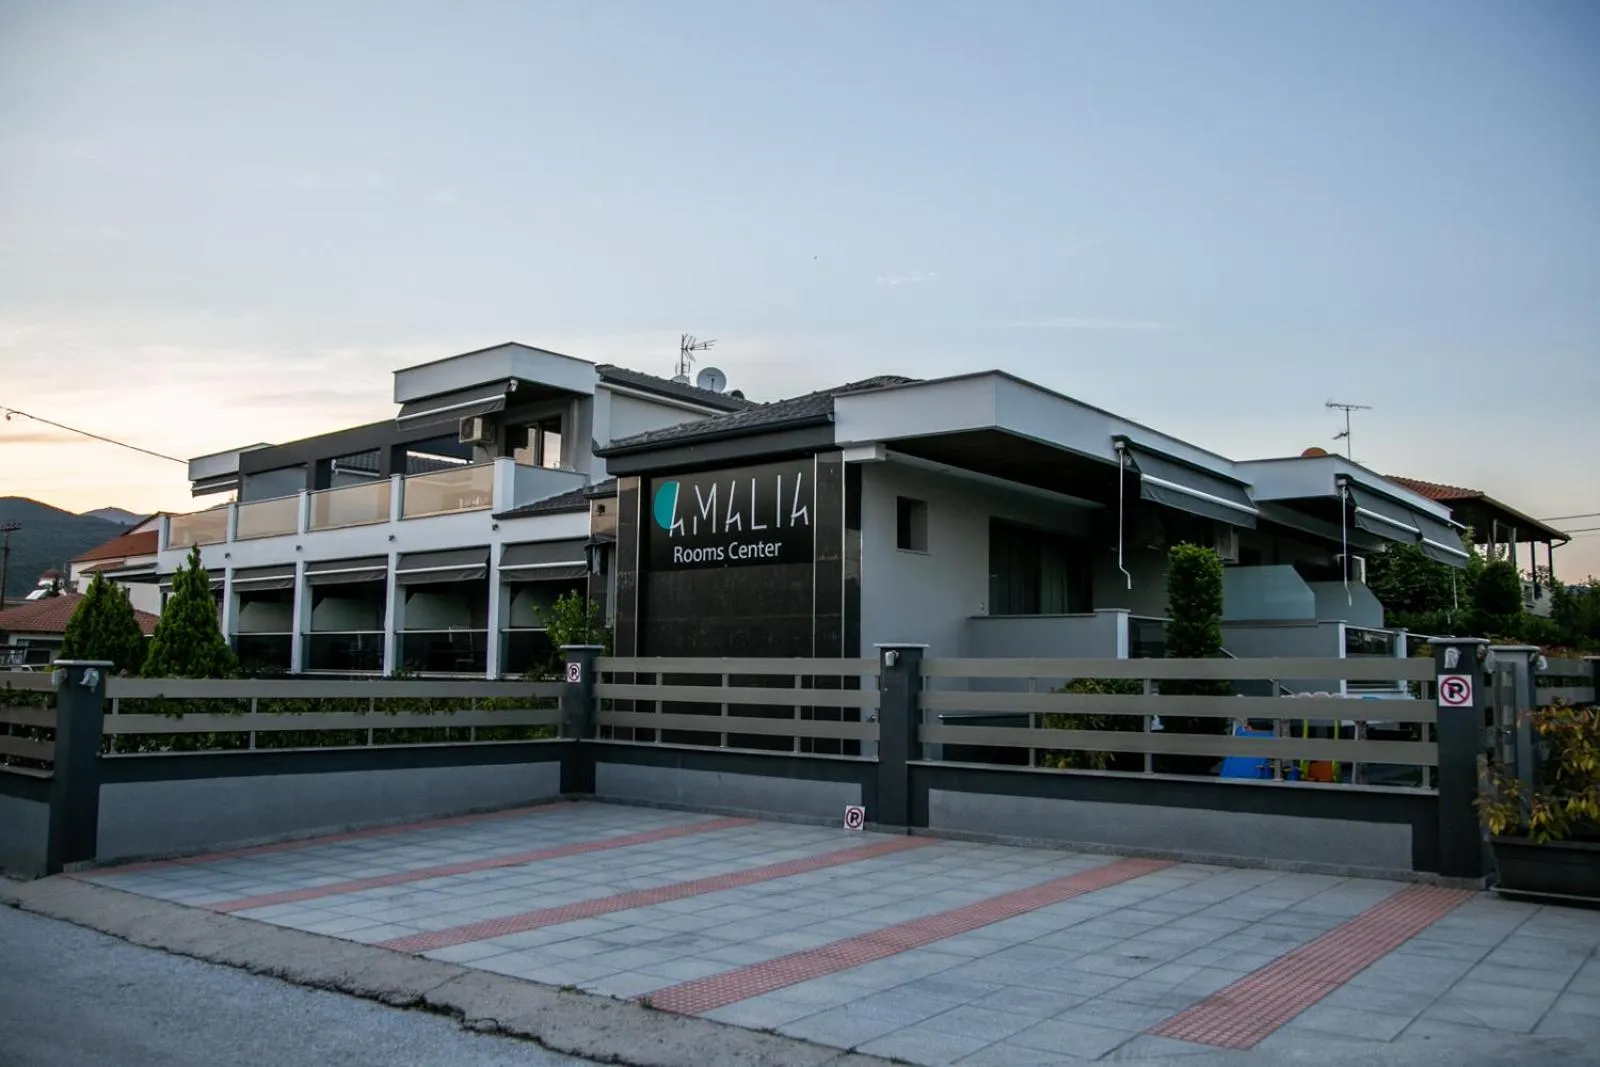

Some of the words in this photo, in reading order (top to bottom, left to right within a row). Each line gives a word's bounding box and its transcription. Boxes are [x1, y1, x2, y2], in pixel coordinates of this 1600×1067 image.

[669, 472, 809, 537] AMALIA
[673, 546, 724, 563] Rooms
[728, 541, 782, 560] Center
